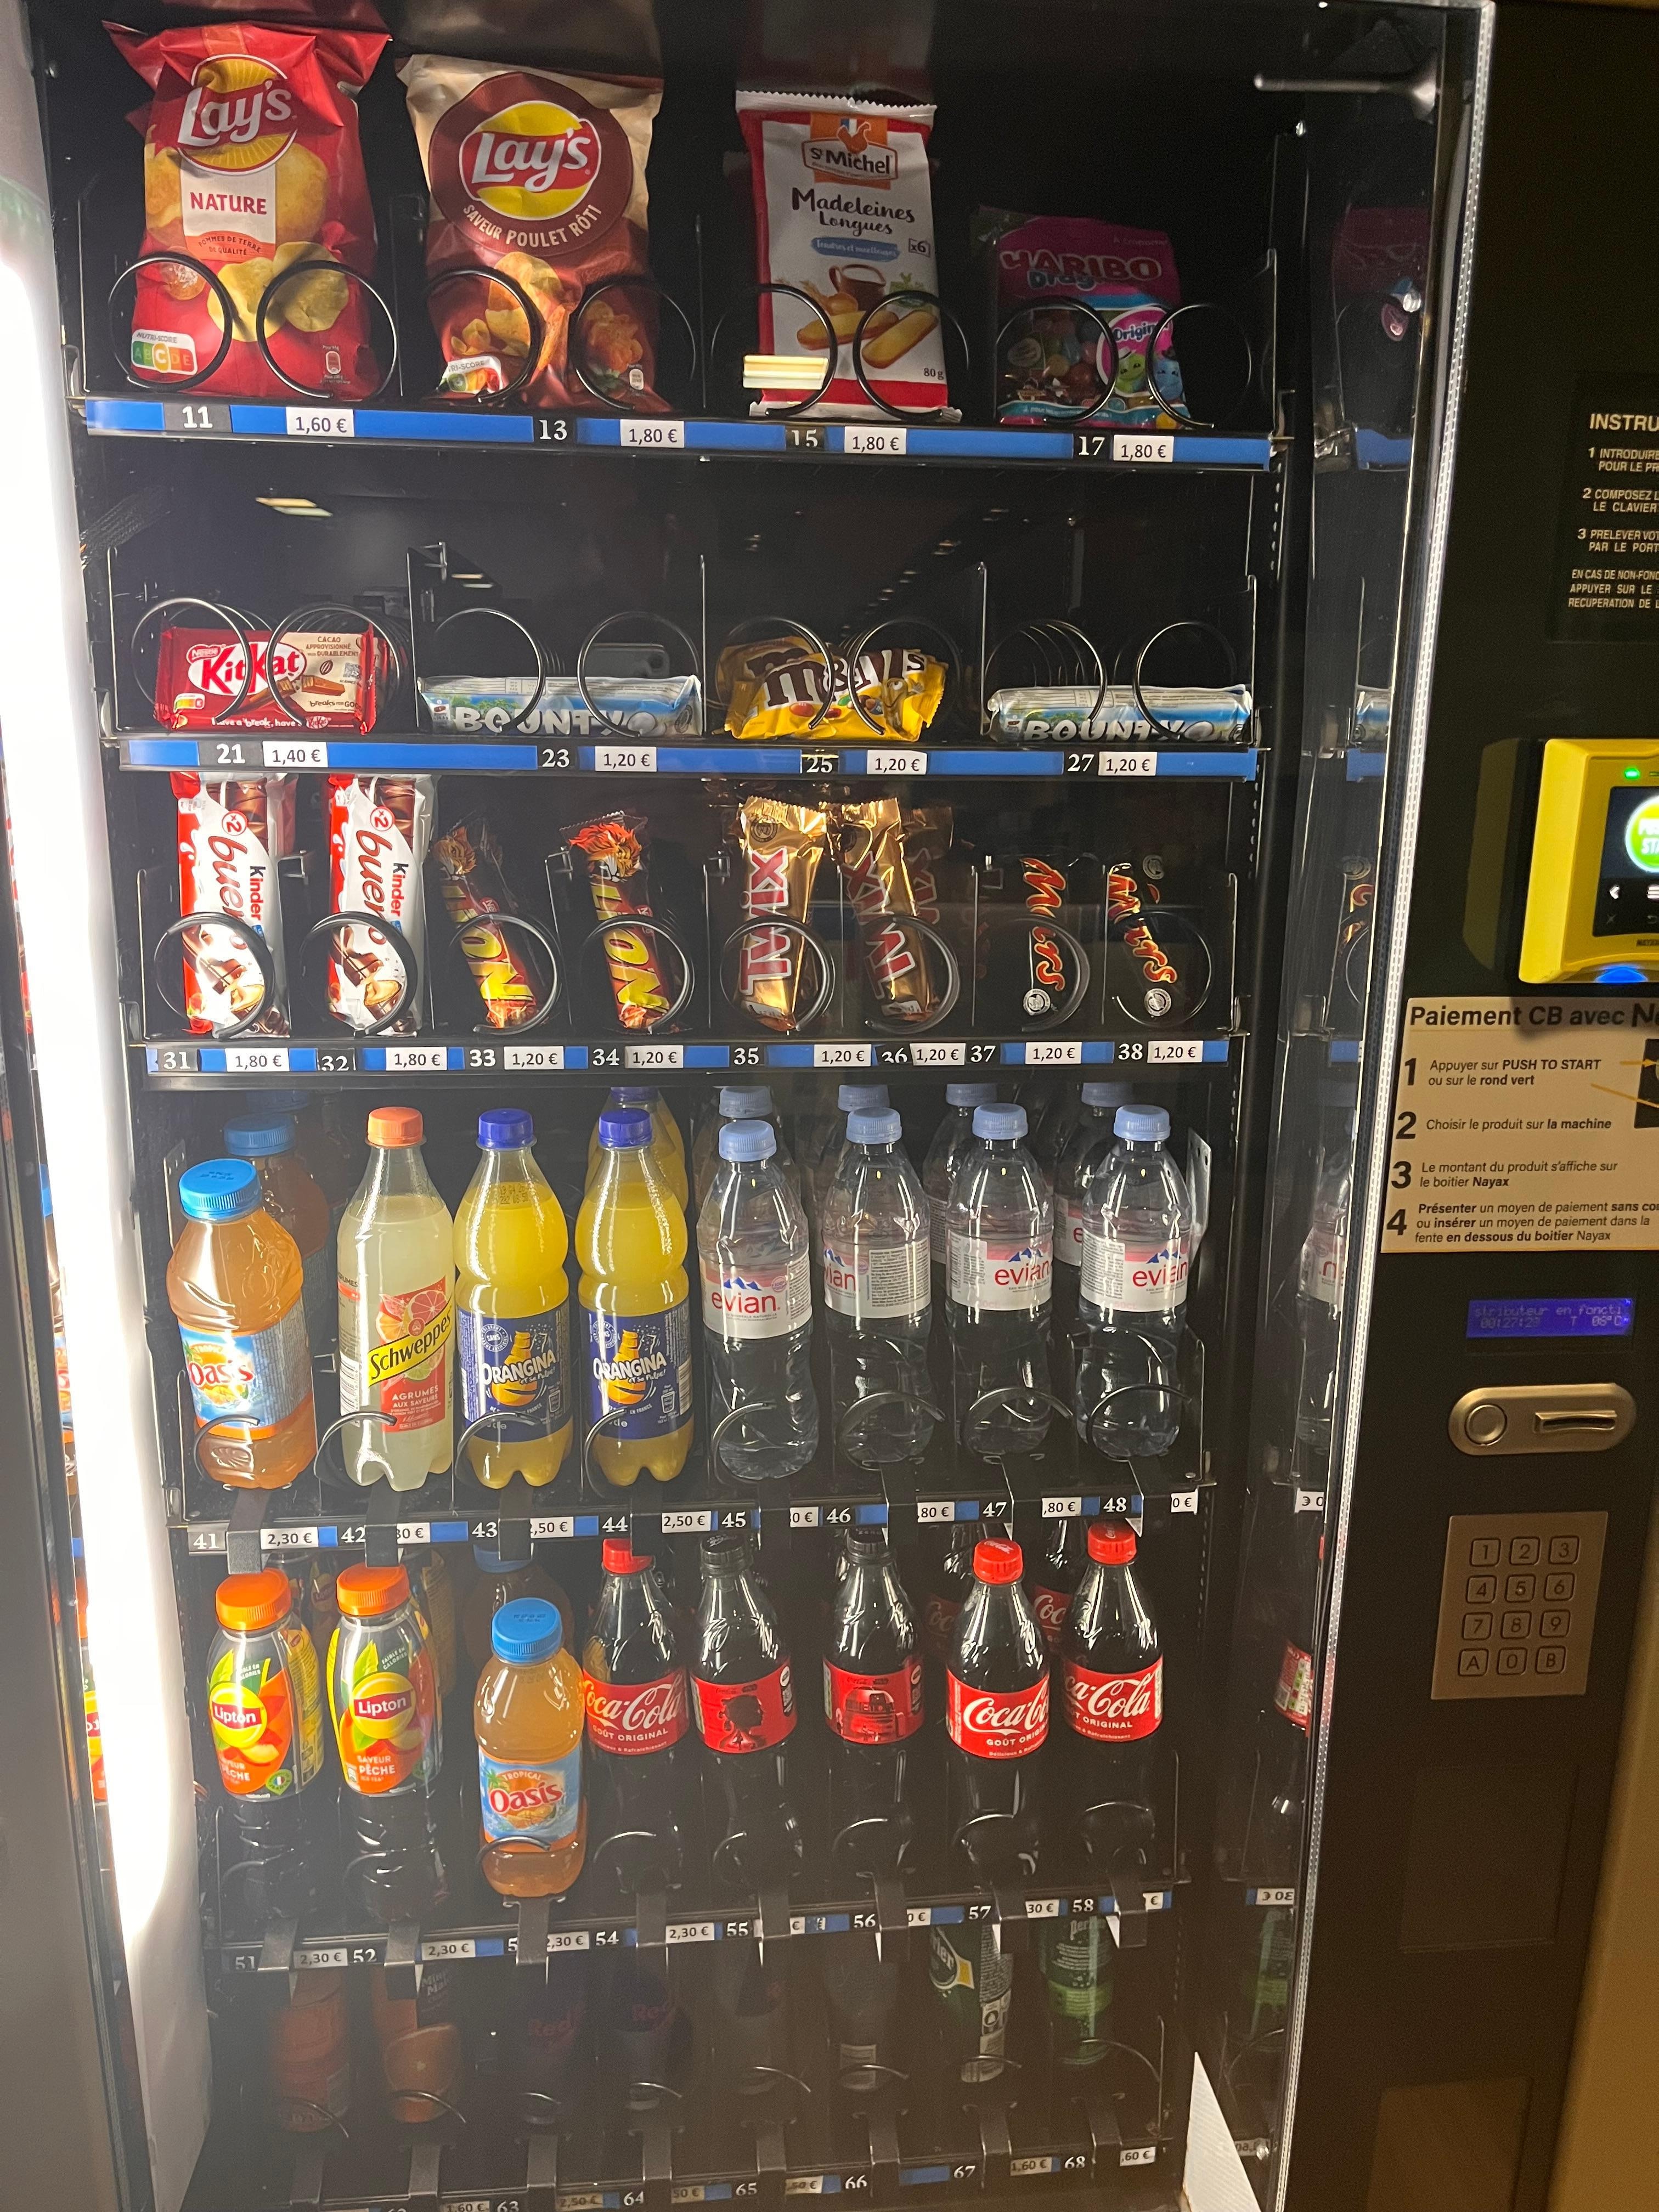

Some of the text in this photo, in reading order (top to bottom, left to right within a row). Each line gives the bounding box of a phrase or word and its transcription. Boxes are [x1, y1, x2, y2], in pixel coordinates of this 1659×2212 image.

[178, 80, 292, 146] Lay's
[471, 129, 591, 193] Lay's
[825, 150, 891, 175] Michel
[190, 192, 267, 215] NATURE
[792, 188, 915, 223] Madeleines
[463, 205, 602, 247] SAVEUR POULET RÔTI
[820, 211, 893, 236] Longues
[199, 236, 224, 247] POMMES
[239, 238, 261, 253] TERRE
[910, 240, 927, 253] x6
[999, 250, 1162, 281] HARIBO
[136, 332, 177, 344] NUTRI-SCORE
[924, 367, 944, 380] 80 g
[183, 407, 212, 429] 11
[295, 417, 347, 433] 1,60 €
[539, 420, 567, 439] 13
[629, 429, 677, 444] 1,80 €
[792, 430, 818, 448] 15
[853, 437, 899, 452] 1,80 €
[1078, 437, 1105, 455] 17
[1121, 444, 1166, 461] 1,80 €
[1589, 448, 1594, 458] 1
[1583, 488, 1651, 500] 2 COMPOSEZ
[1593, 501, 1656, 512] LE CLAVIER
[1589, 543, 1608, 551] PAR
[1615, 543, 1626, 552] LE
[1570, 584, 1652, 594] APPUYER SUR LE
[217, 744, 245, 763] 21
[273, 749, 320, 765] 1,40 €
[542, 749, 570, 768] 23
[603, 754, 650, 769] 1,20 €
[806, 757, 833, 773] 25
[875, 758, 919, 772] 1,20 €
[1068, 754, 1094, 772] 27
[1106, 759, 1149, 774] 1,20 €
[249, 866, 266, 921] Kinder
[391, 862, 409, 917] Kinder
[1410, 1005, 1520, 1026] Paiement
[1529, 1006, 1562, 1025] CB
[1570, 1010, 1624, 1025] avec
[592, 1048, 620, 1065] 34
[633, 1052, 676, 1066] 1,20 €
[733, 1048, 759, 1064] 35
[822, 1050, 864, 1063] 1,20 €
[1118, 1044, 1143, 1060] 38
[1154, 1047, 1196, 1059] 1,20 €
[163, 1052, 190, 1069] 31
[235, 1056, 281, 1070] 1,80 €
[1404, 1058, 1417, 1086] 1
[1430, 1060, 1477, 1072] Appuyer
[1503, 1060, 1536, 1070] PUSH
[1542, 1060, 1558, 1069] TO
[1561, 1059, 1601, 1070] START
[1396, 1111, 1611, 1139] 2 Choisir le produit sur la machine
[1420, 1177, 1509, 1189] le boitier Nayax
[1386, 1209, 1407, 1235] 4
[1415, 1231, 1611, 1243] fente en dessous du boitier Nayax
[712, 1292, 776, 1314] evian
[371, 1313, 451, 1380] Schweppes
[482, 1350, 556, 1385] ORANGINA
[594, 1352, 667, 1380] ORANGINA
[392, 1385, 438, 1401] AGRUMES
[410, 1393, 438, 1406] SAVEURS
[983, 1502, 1007, 1517] 47
[602, 1517, 628, 1532] 44
[664, 1515, 706, 1527] 2,50 €
[193, 1534, 219, 1549] 41
[268, 1533, 312, 1546] 2,30 €
[1483, 1545, 1488, 1559] 1
[1519, 1544, 1530, 1559] 2
[1559, 1543, 1568, 1558] 3
[1477, 1582, 1487, 1596] 4
[1515, 1581, 1526, 1596] 5
[1554, 1580, 1565, 1594] 6
[1474, 1620, 1483, 1633] 7
[1511, 1618, 1521, 1633] 8
[1550, 1616, 1561, 1630] 9
[1466, 1656, 1480, 1670] A
[1546, 1653, 1556, 1667] B
[358, 1697, 406, 1714] Lipton
[214, 1705, 256, 1723] Lipton
[593, 1725, 668, 1741] GOÛT ORIGINAL
[359, 1764, 396, 1775] PÊCHE
[489, 1782, 563, 1812] Oasis
[969, 1905, 991, 1920] 57
[1073, 1899, 1094, 1912] 58
[669, 1927, 709, 1940] 2,30 €
[726, 1922, 749, 1936] 55
[301, 1953, 342, 1964] 2,30 €
[1012, 2159, 1046, 2172] 1,60 €
[1065, 2156, 1085, 2169] 68
[845, 2175, 867, 2189] 66
[623, 2192, 645, 2205] 64
